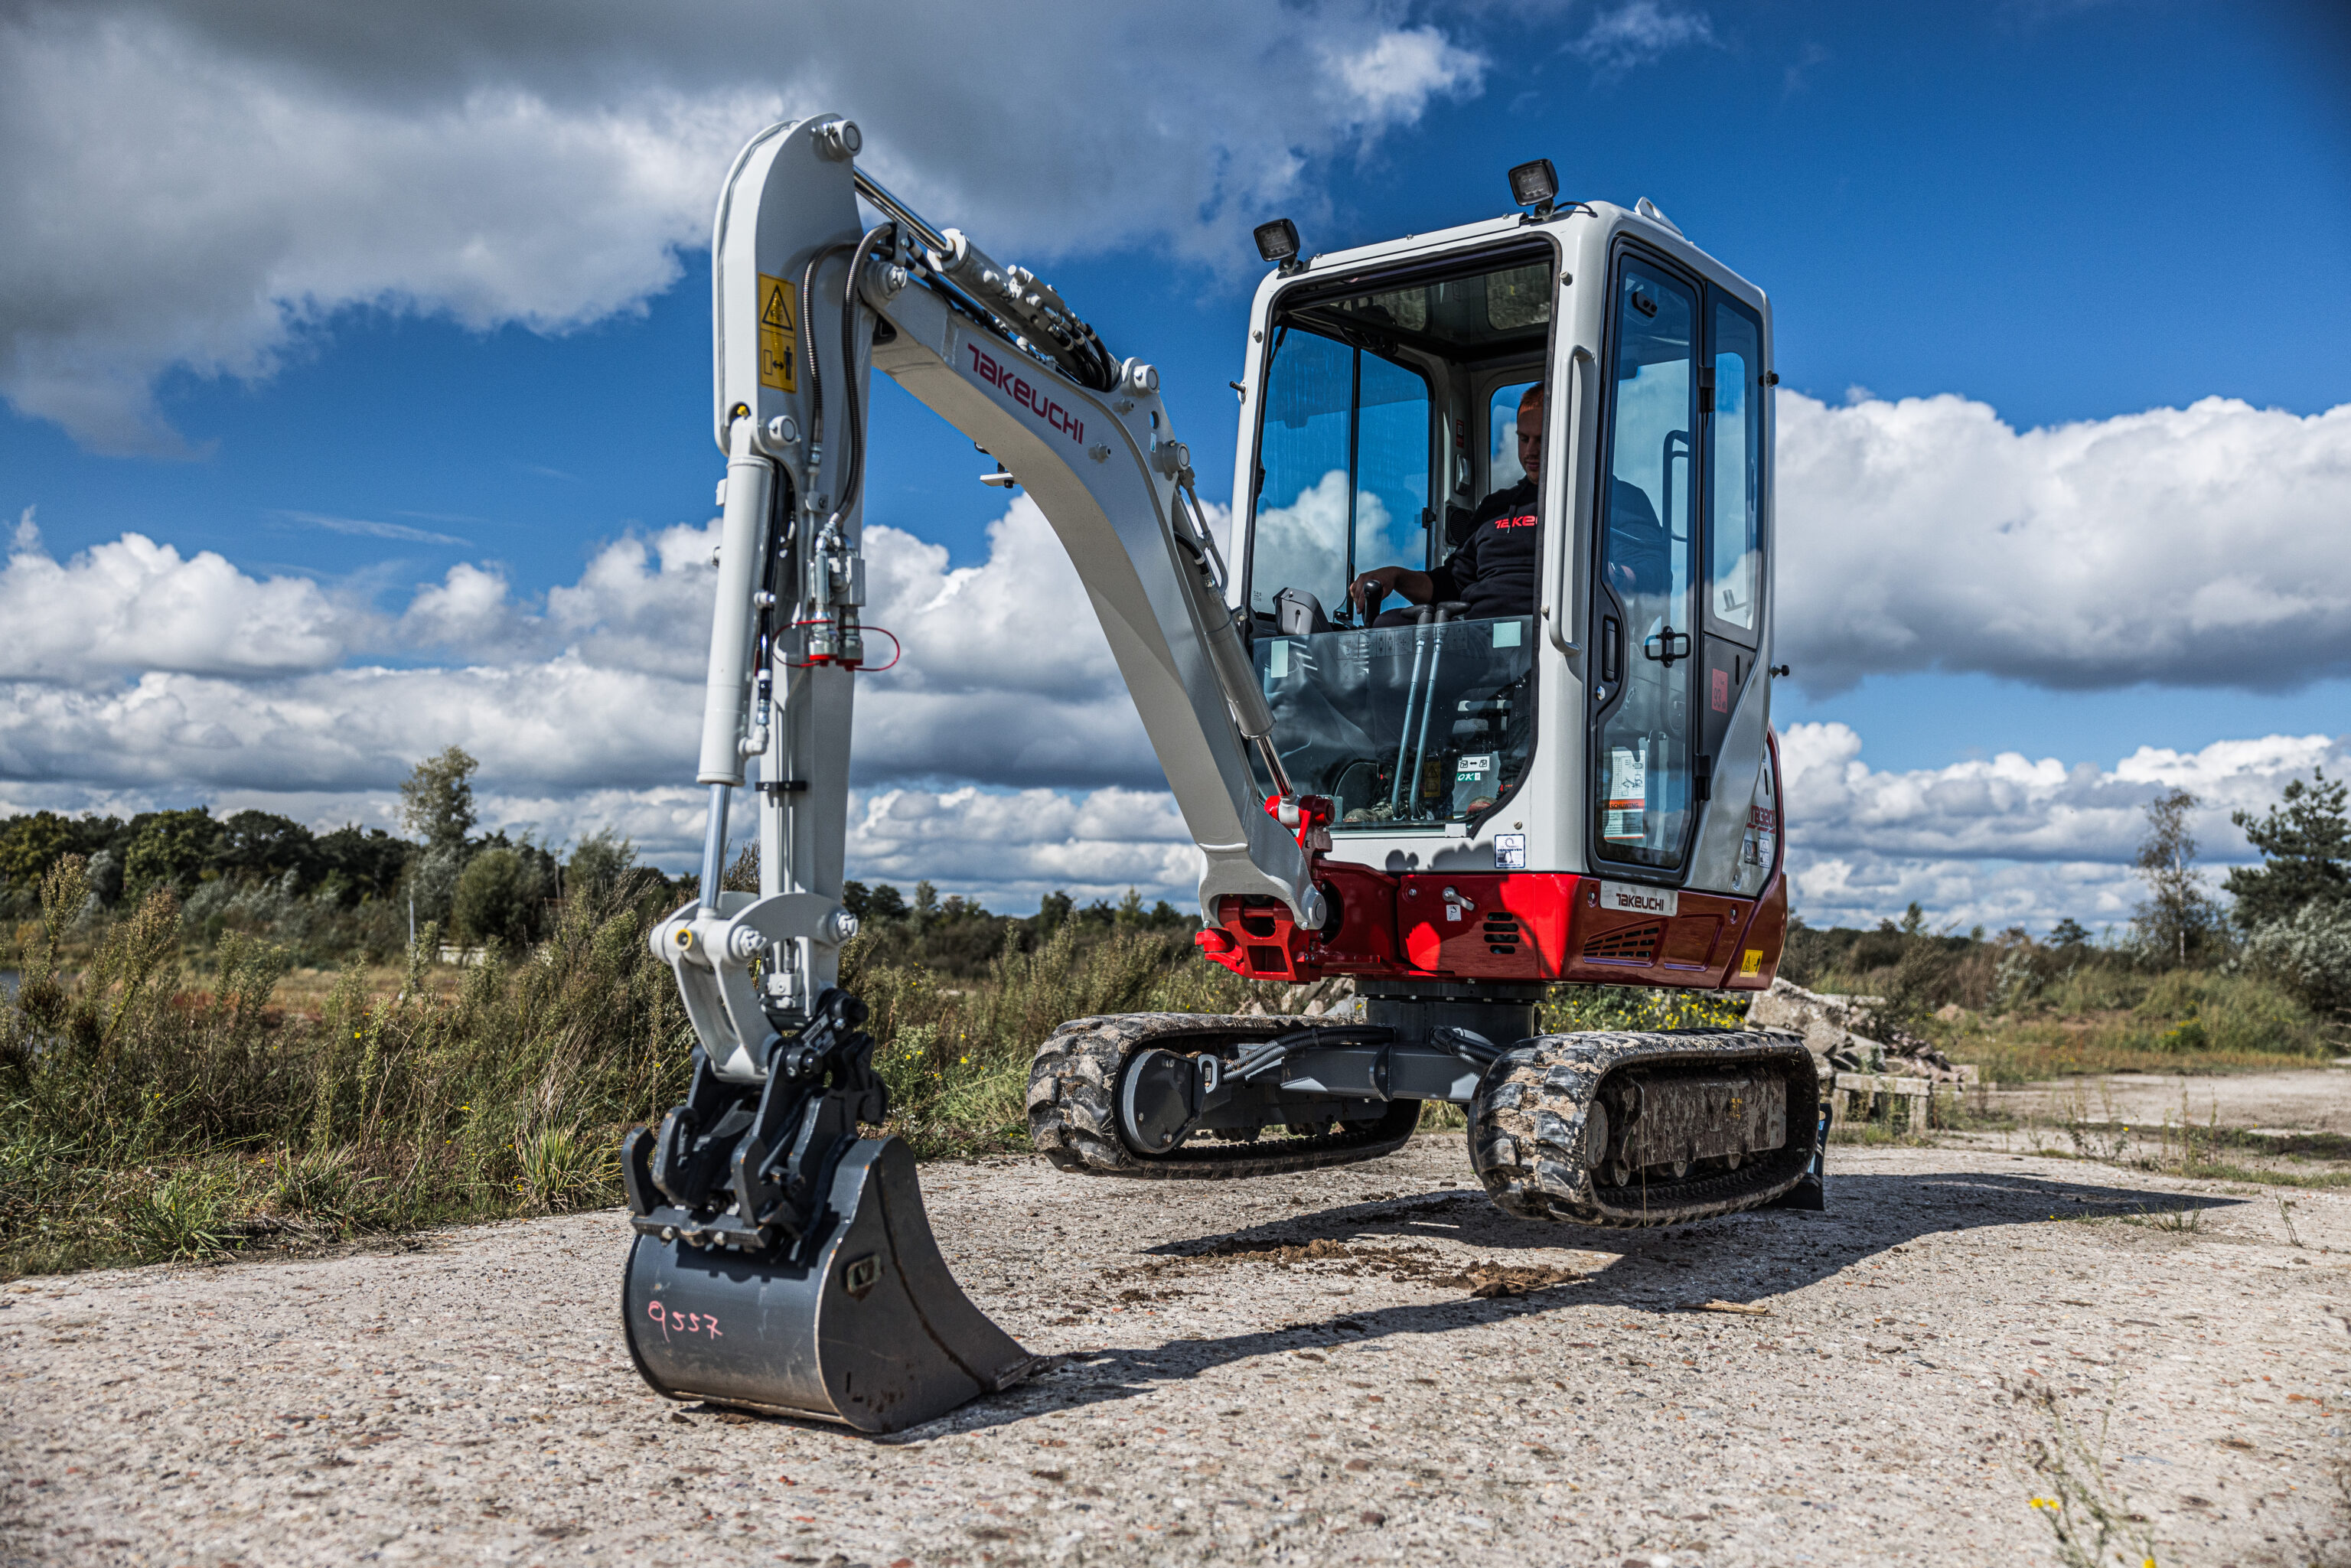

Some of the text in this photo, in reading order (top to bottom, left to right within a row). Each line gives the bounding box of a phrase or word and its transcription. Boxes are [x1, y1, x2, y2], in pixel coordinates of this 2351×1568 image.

[967, 343, 1084, 445] TAKEUCHI
[1457, 772, 1474, 781] OK
[1616, 892, 1665, 911] TAKEUCHI
[647, 1300, 723, 1343] 9557
